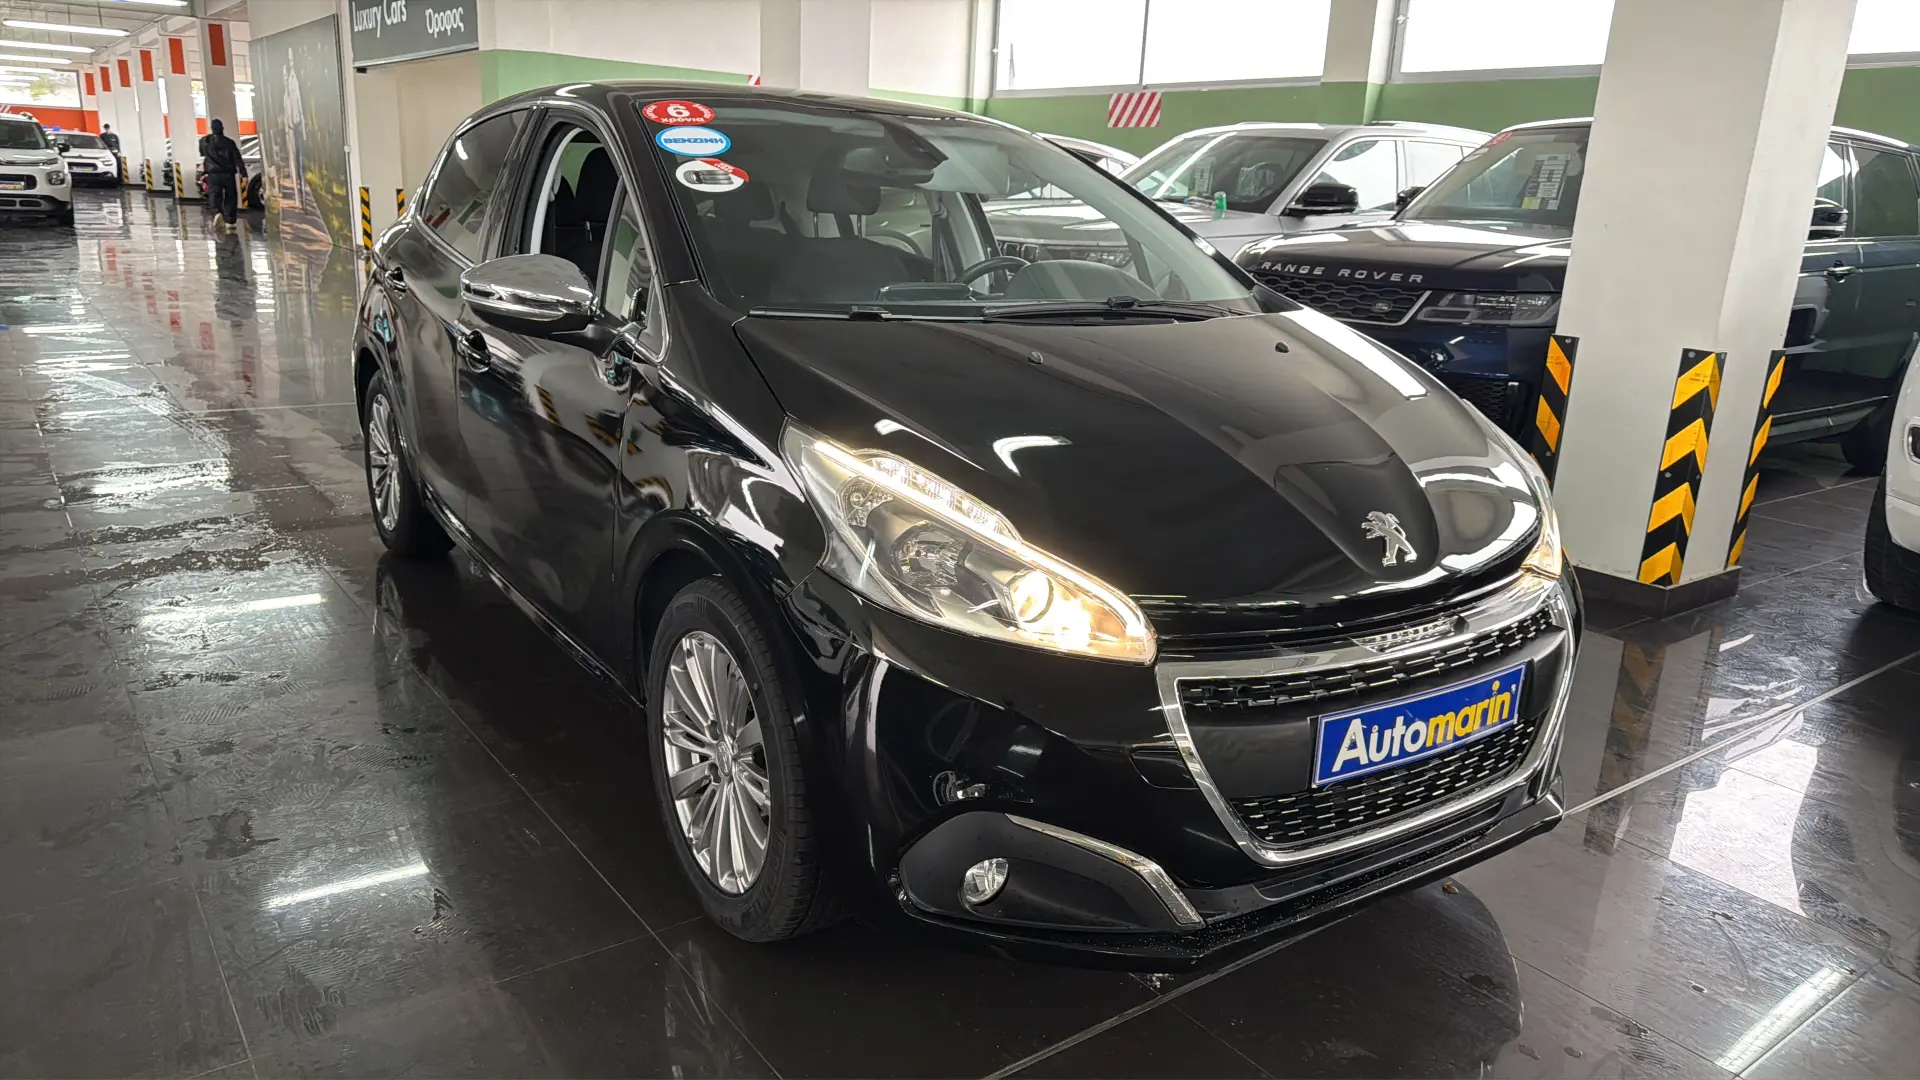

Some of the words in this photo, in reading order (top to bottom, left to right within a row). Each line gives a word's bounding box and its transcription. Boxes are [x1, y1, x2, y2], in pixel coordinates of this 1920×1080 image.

[352, 1, 382, 38] Luxury
[384, 0, 407, 25] Cars
[667, 105, 690, 118] 6
[1261, 261, 1325, 276] RANGE
[1338, 268, 1425, 284] ROVER
[1331, 680, 1512, 772] Automarin
